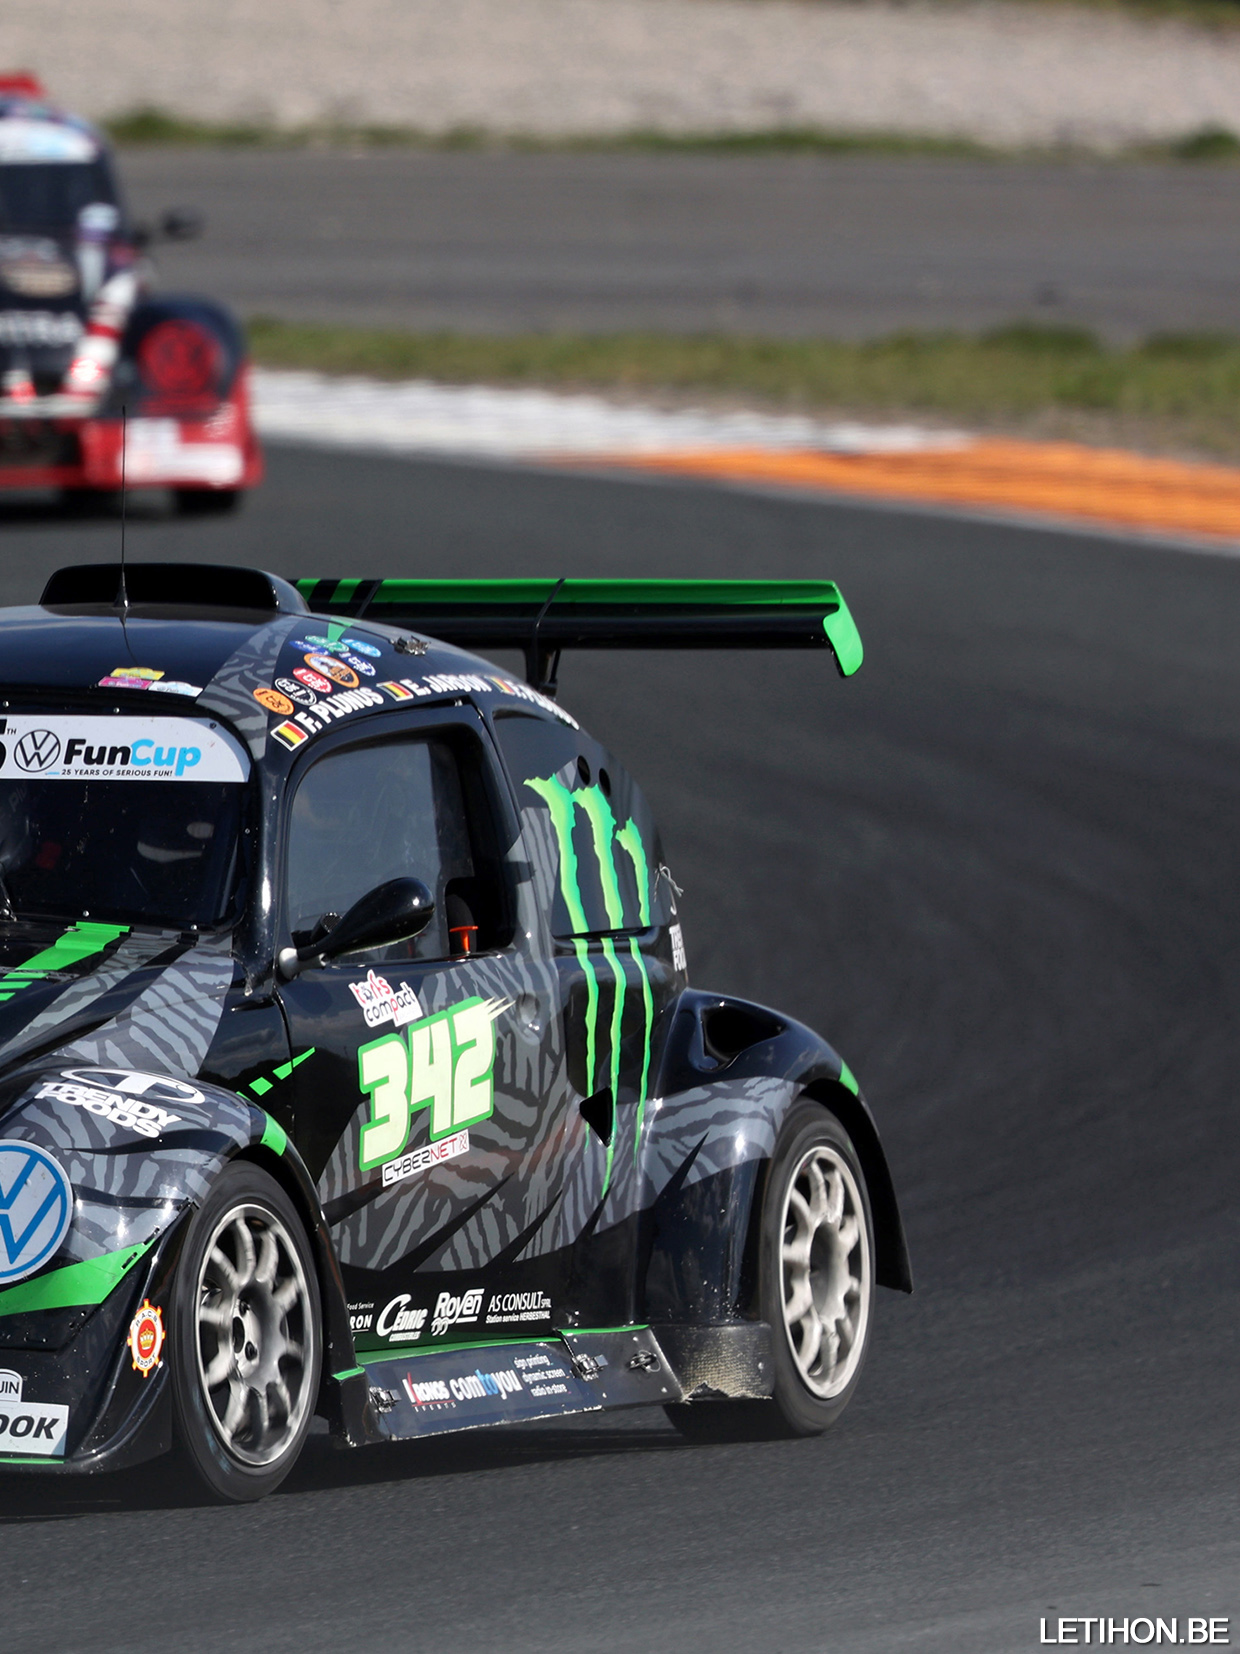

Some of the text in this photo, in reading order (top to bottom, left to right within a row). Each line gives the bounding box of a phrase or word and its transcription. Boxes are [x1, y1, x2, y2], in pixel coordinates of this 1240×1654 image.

[294, 711, 323, 735] F.
[63, 738, 202, 776] FunCup
[154, 769, 173, 777] FUN!
[366, 984, 416, 1022] compact
[359, 996, 505, 1172] 342
[34, 1090, 160, 1138] FOODS
[41, 1082, 182, 1127] TRENDY
[488, 1295, 502, 1312] AS
[502, 1291, 544, 1311] CONSULT
[349, 1314, 373, 1329] RON
